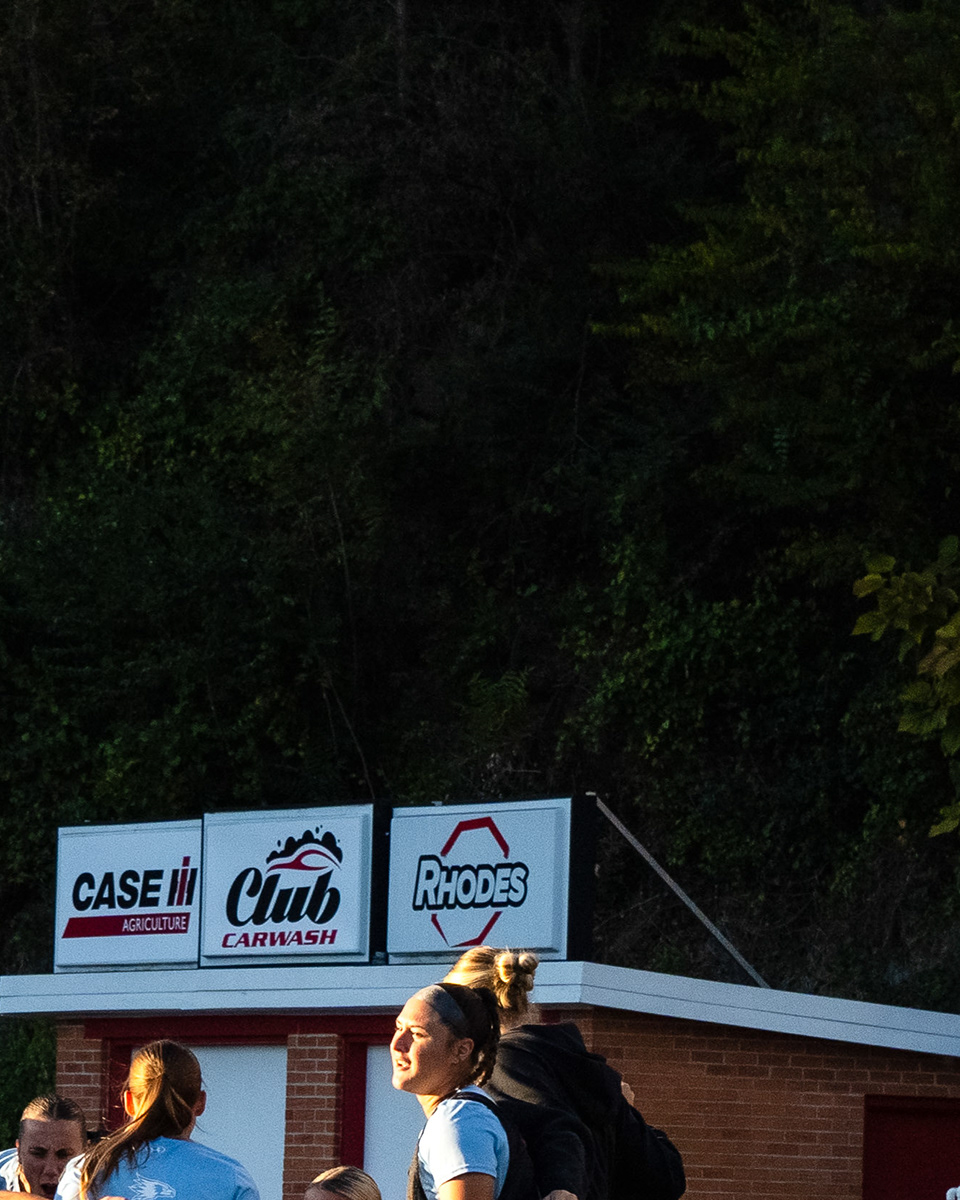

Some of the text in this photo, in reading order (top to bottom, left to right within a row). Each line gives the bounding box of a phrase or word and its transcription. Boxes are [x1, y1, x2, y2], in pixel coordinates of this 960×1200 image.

[72, 869, 164, 912] CASE
[225, 867, 341, 927] Club
[122, 916, 187, 932] AGRICULTURE
[221, 929, 338, 948] CARWASH
